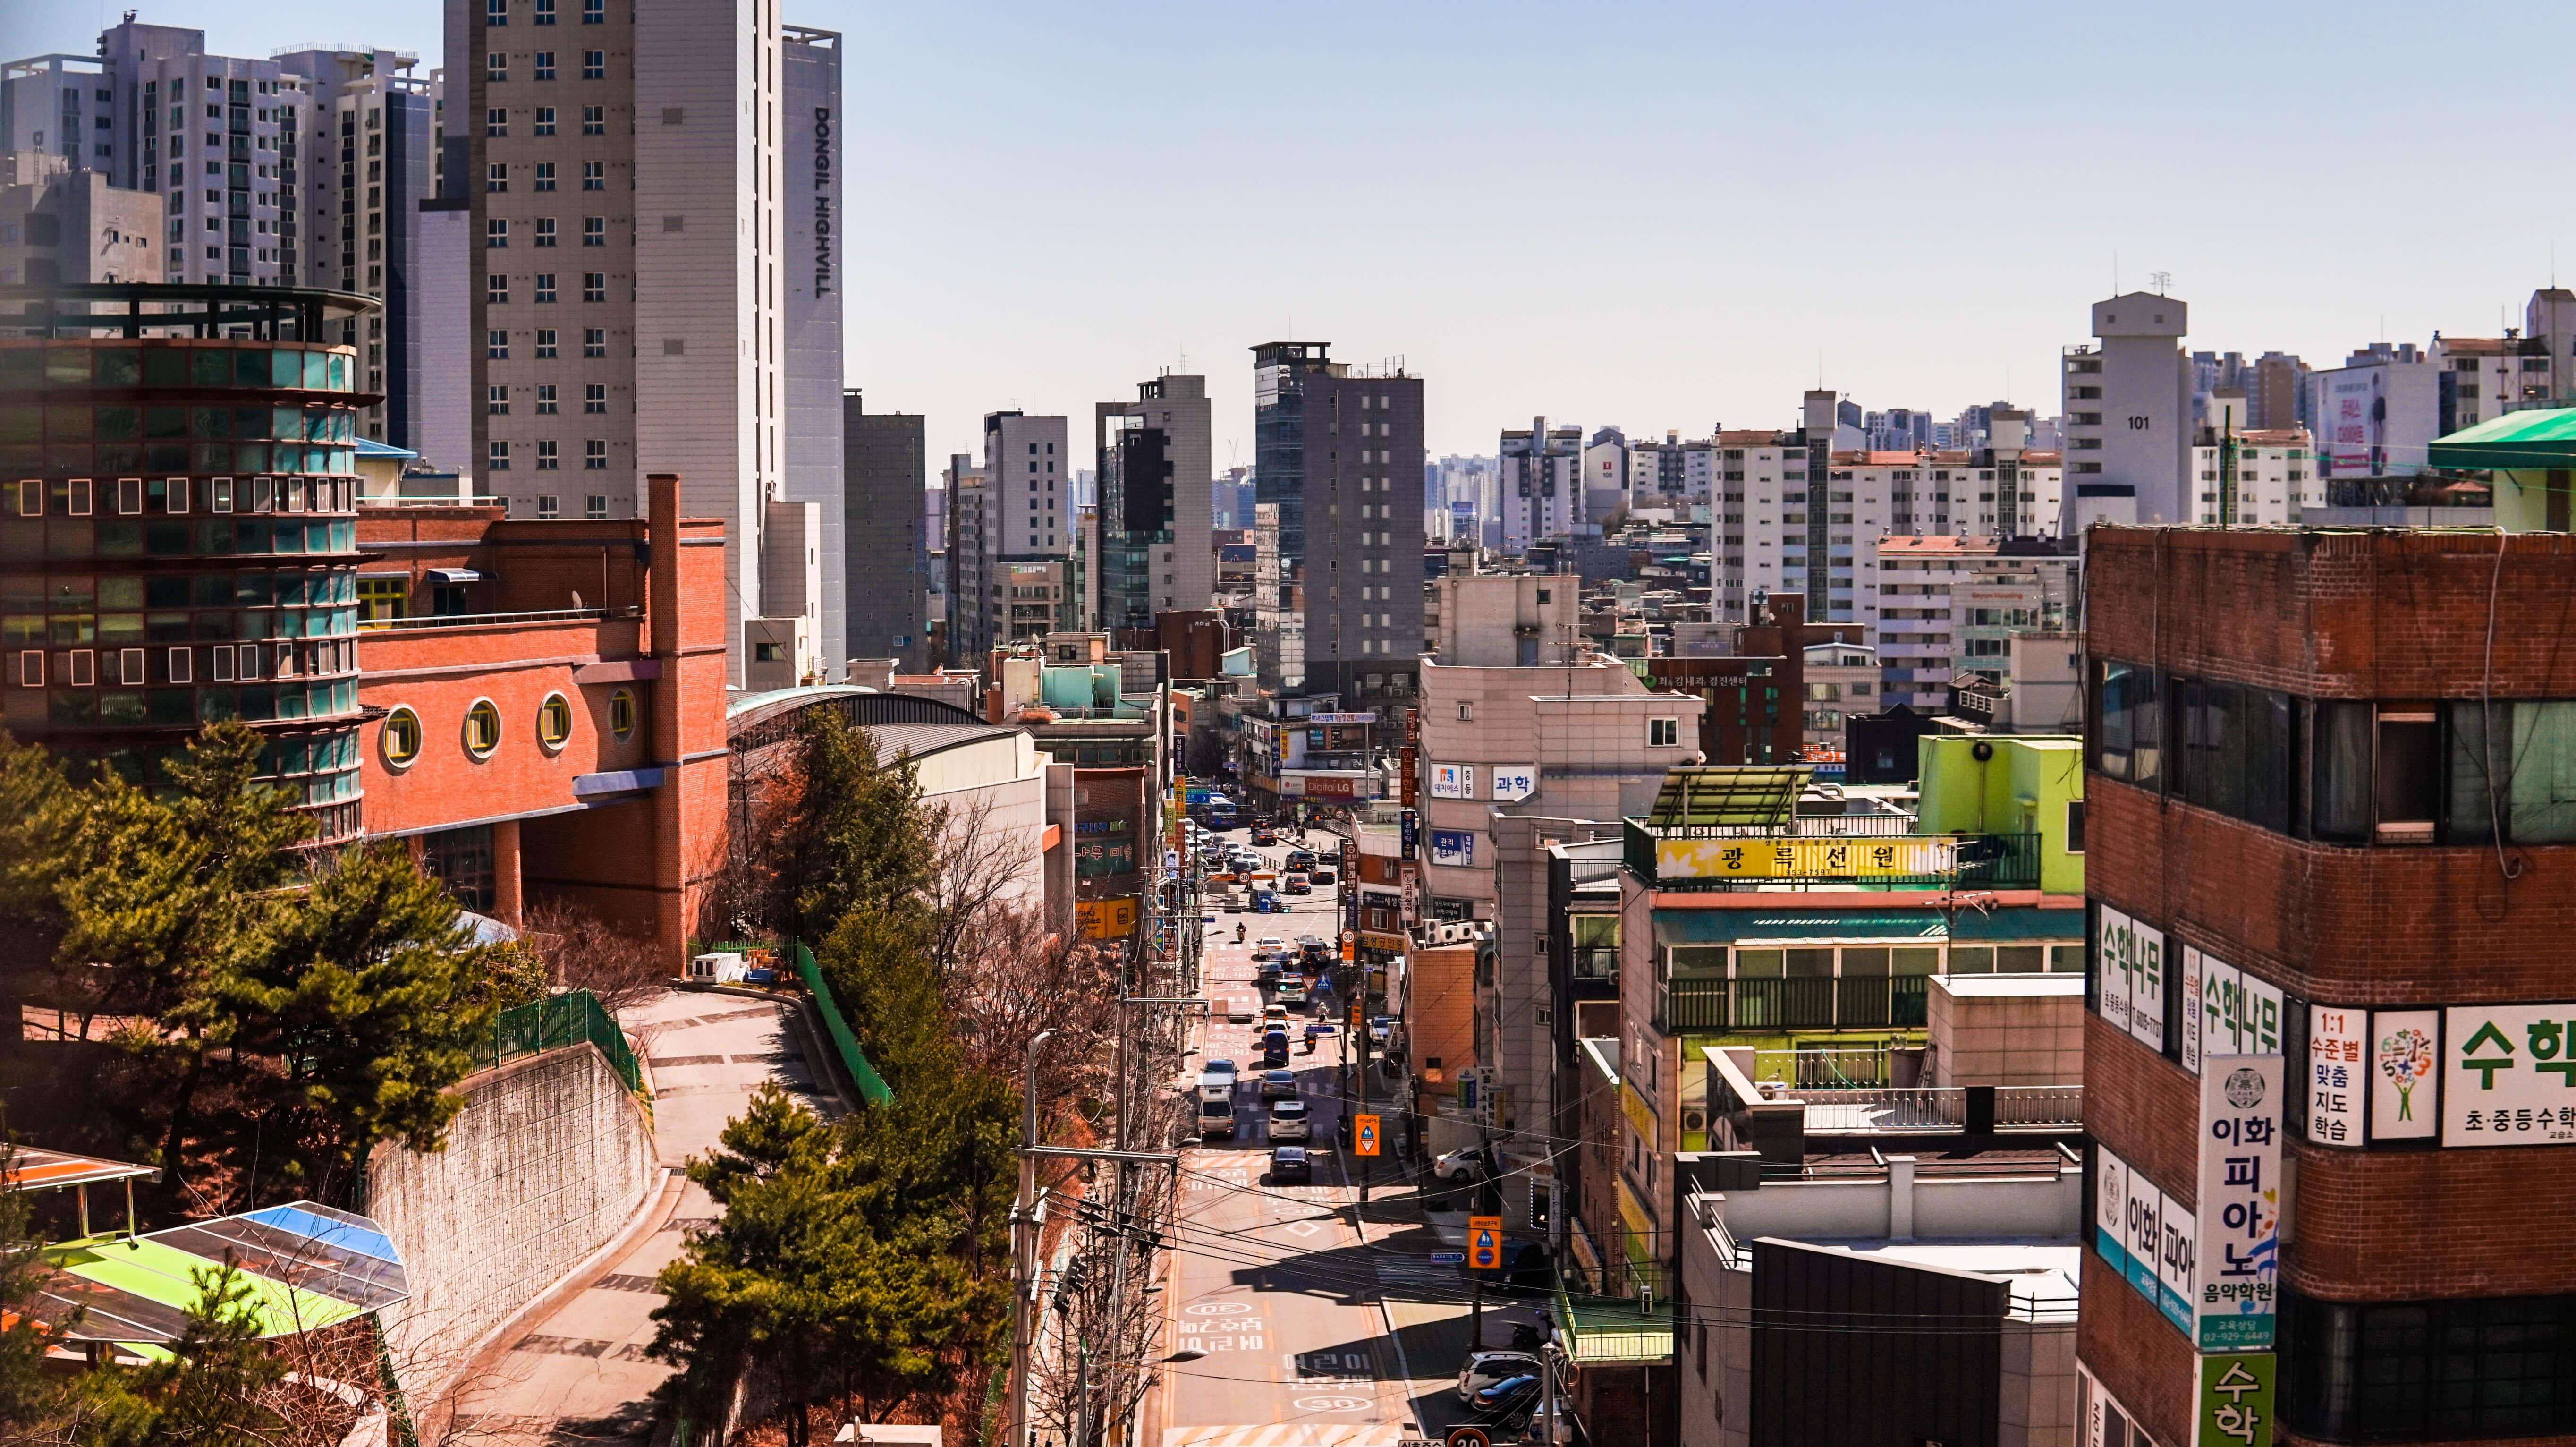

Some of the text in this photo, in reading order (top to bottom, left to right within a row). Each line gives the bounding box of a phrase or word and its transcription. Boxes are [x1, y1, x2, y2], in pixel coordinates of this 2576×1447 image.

[815, 107, 830, 298] DONGIL HIGHVILL
[2128, 416, 2149, 430] 101
[1709, 676, 1747, 687] 검진센터
[1309, 782, 1335, 793] Digital
[1337, 783, 1349, 792] LG
[1402, 751, 1414, 804] 안동한우
[1434, 784, 1459, 793] 대치에스
[1464, 770, 1472, 794] 중등
[1496, 776, 1530, 792] 과학
[1110, 843, 1132, 861] 미술
[1441, 838, 1454, 847] 관리
[1347, 861, 1356, 888] 빨래방
[2104, 920, 2159, 1000] 수학나무
[2206, 971, 2277, 1055] 수학나무
[2322, 1013, 2344, 1034] 1:1
[2312, 1037, 2359, 1062] 수준별
[2462, 1020, 2576, 1090] 수학
[2317, 1064, 2349, 1089] 맞춤
[2316, 1092, 2348, 1113] 지도
[2212, 1116, 2275, 1146] 이화
[2315, 1116, 2347, 1141] 학습
[2220, 1156, 2262, 1276] 피아노
[2130, 1197, 2157, 1262] 이화
[2203, 1283, 2272, 1302] 음악학원
[2203, 1331, 2270, 1342] 02-929-6449
[2218, 1321, 2256, 1331] 교육상담
[1285, 1353, 1369, 1370] 어린이
[1311, 1399, 1355, 1409] 30
[2213, 1361, 2260, 1446] 수학
